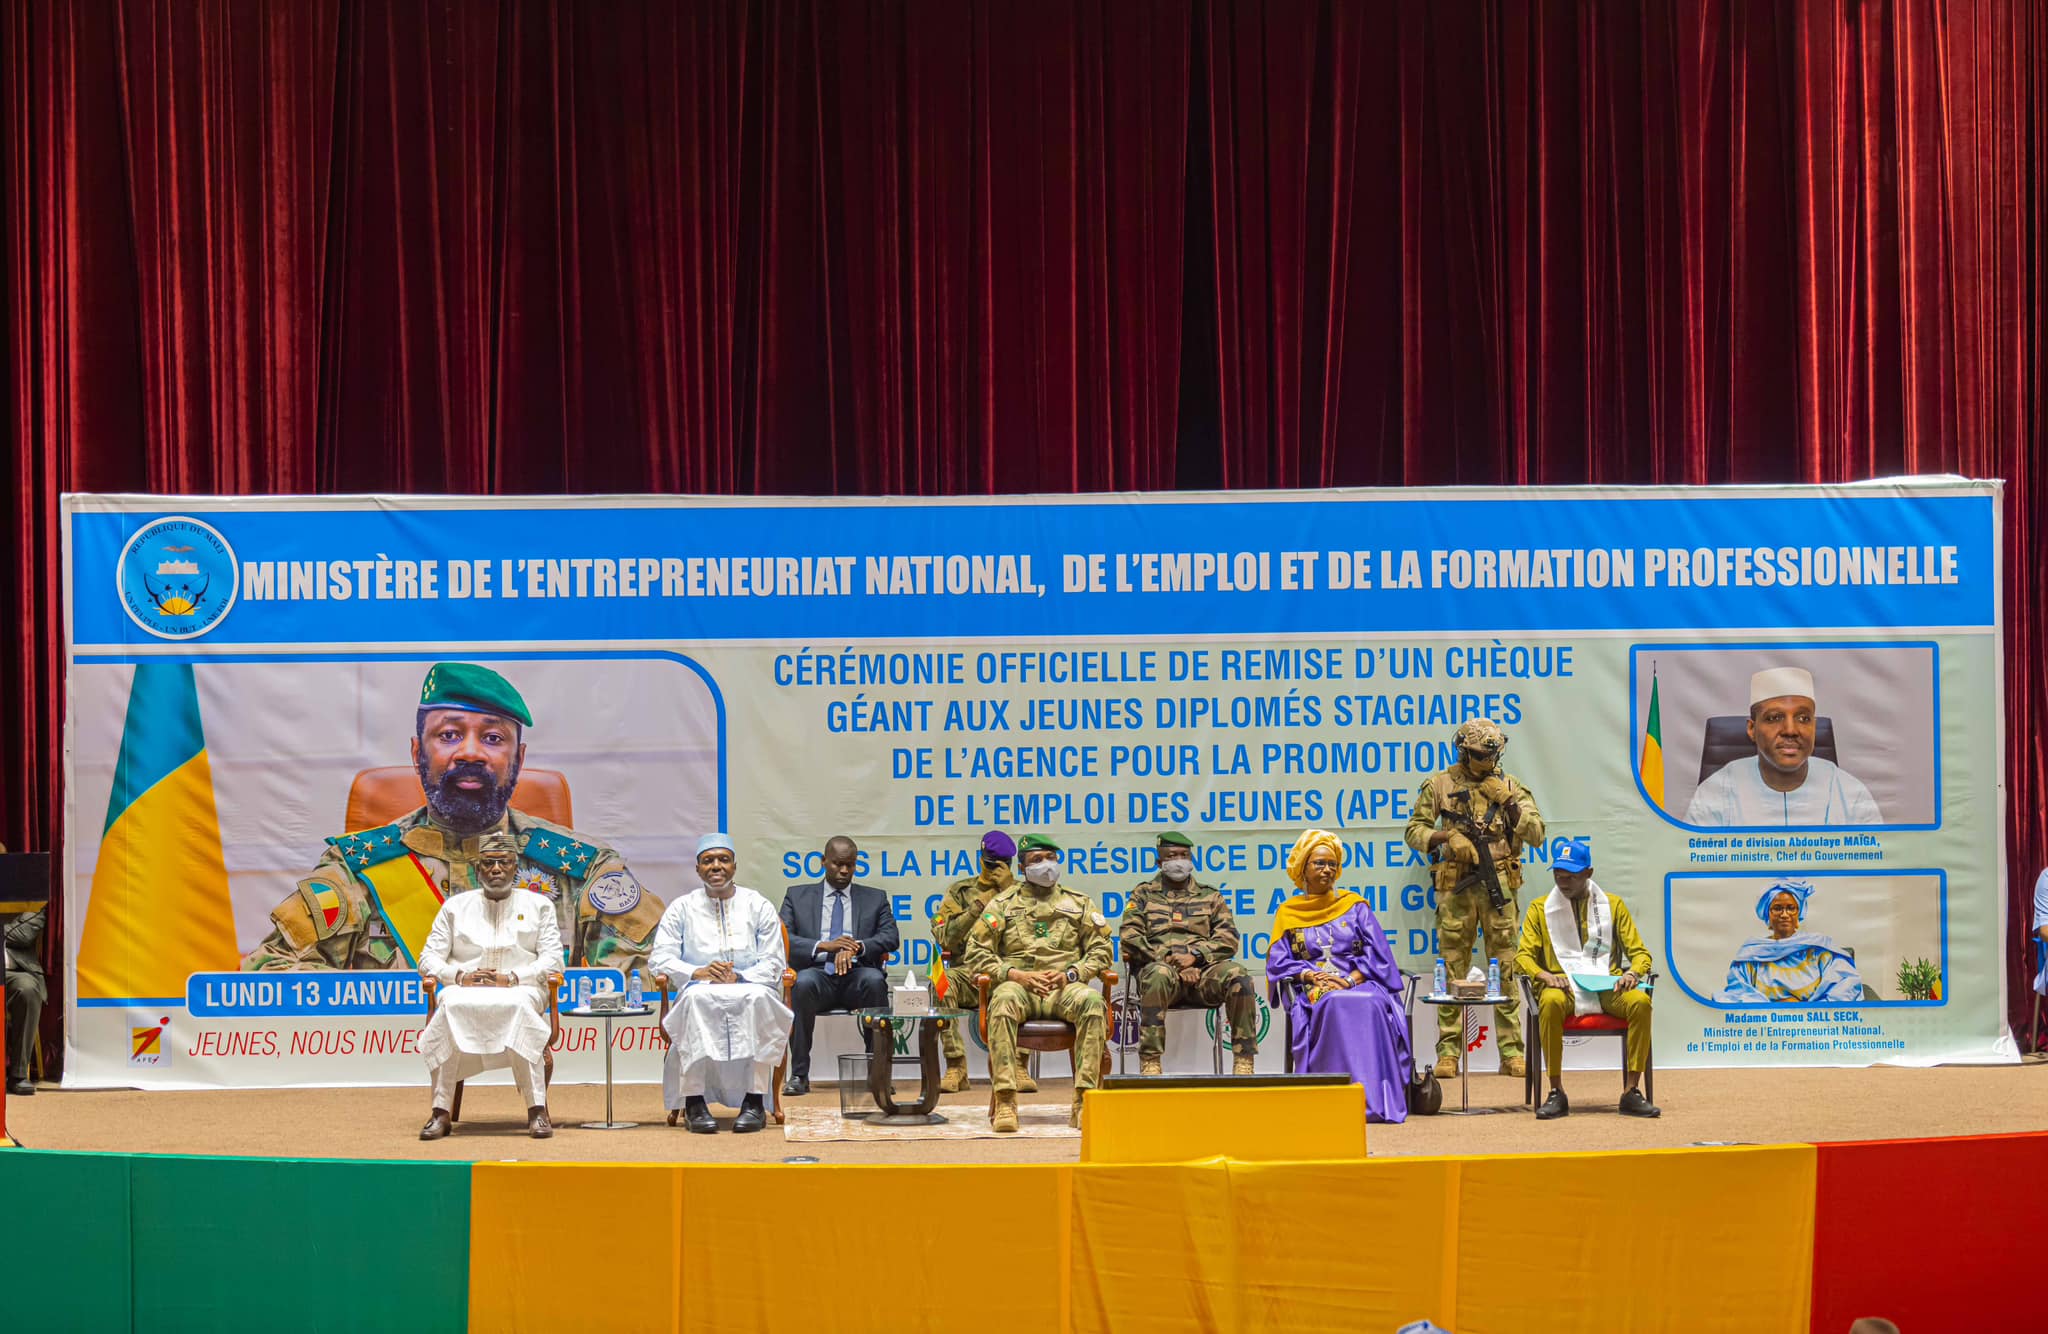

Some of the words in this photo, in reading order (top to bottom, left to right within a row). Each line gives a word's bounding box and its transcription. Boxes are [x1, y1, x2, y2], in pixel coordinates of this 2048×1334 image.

[244, 554, 438, 600] MINISTÈRE
[449, 560, 491, 598] DE
[502, 557, 856, 597] L’ENTREPRENEURIAT
[866, 556, 1044, 596] NATIONAL,
[1064, 555, 1106, 592] DE
[1117, 553, 1269, 592] L’EMPLOI
[1282, 552, 1318, 589] ET
[1329, 552, 1371, 589] DE
[1382, 551, 1422, 588] LA
[1432, 549, 1633, 588] FORMATION
[1645, 547, 1958, 586] PROFESSIONNELLE
[775, 646, 965, 686] CÉRÉMONIE
[977, 651, 1157, 685] OFFICIELLE
[1169, 650, 1210, 682] DE
[1221, 648, 1343, 681] REMISE
[1355, 647, 1433, 680] D’UN
[1446, 639, 1574, 680] CHÈQUE
[828, 694, 934, 733] GÉANT
[944, 700, 1010, 732] AUX
[1020, 698, 1144, 731] JEUNES
[1156, 688, 1323, 729] DIPLOMÉS
[1334, 693, 1522, 727] STAGIAIRES
[893, 748, 933, 780] DE
[946, 746, 1099, 779] L’AGENCE
[1111, 745, 1200, 777] POUR
[1213, 744, 1252, 776] LA
[1263, 741, 1459, 775] PROMOTION
[915, 795, 955, 826] DE
[967, 793, 1115, 826] L’EMPLOI
[1129, 791, 1190, 824] DES
[1200, 789, 1324, 823] JEUNES
[1689, 838, 1727, 849] Général
[1731, 838, 1742, 848] de
[1746, 837, 1785, 848] division
[1789, 837, 1840, 849] Abdoulaye
[1844, 834, 1880, 847] MAÏGA,
[784, 850, 871, 879] SOS
[882, 850, 922, 877] LA
[1690, 852, 1727, 863] Premier
[1776, 850, 1798, 861] Chef
[1801, 850, 1812, 861] du
[1815, 850, 1883, 861] Gouvernement
[207, 983, 281, 1006] LUNDI
[292, 982, 319, 1005] 13
[1726, 1013, 1767, 1023] Madame
[1771, 1012, 1804, 1022] Oumou
[1807, 1012, 1831, 1022] SALL
[1834, 1011, 1863, 1023] SECK,
[189, 1031, 281, 1058] JEUNES,
[291, 1030, 356, 1056] NOUS
[549, 1026, 597, 1052] OUR
[611, 1026, 665, 1051] VOTR
[1687, 1042, 1699, 1052] de
[1744, 1041, 1753, 1051] et
[1755, 1041, 1767, 1051] de
[1770, 1040, 1779, 1050] la
[1782, 1040, 1830, 1051] Formation
[1833, 1039, 1905, 1050] Professionnelle
[1704, 1027, 1743, 1038] Ministre
[1746, 1027, 1758, 1037] de
